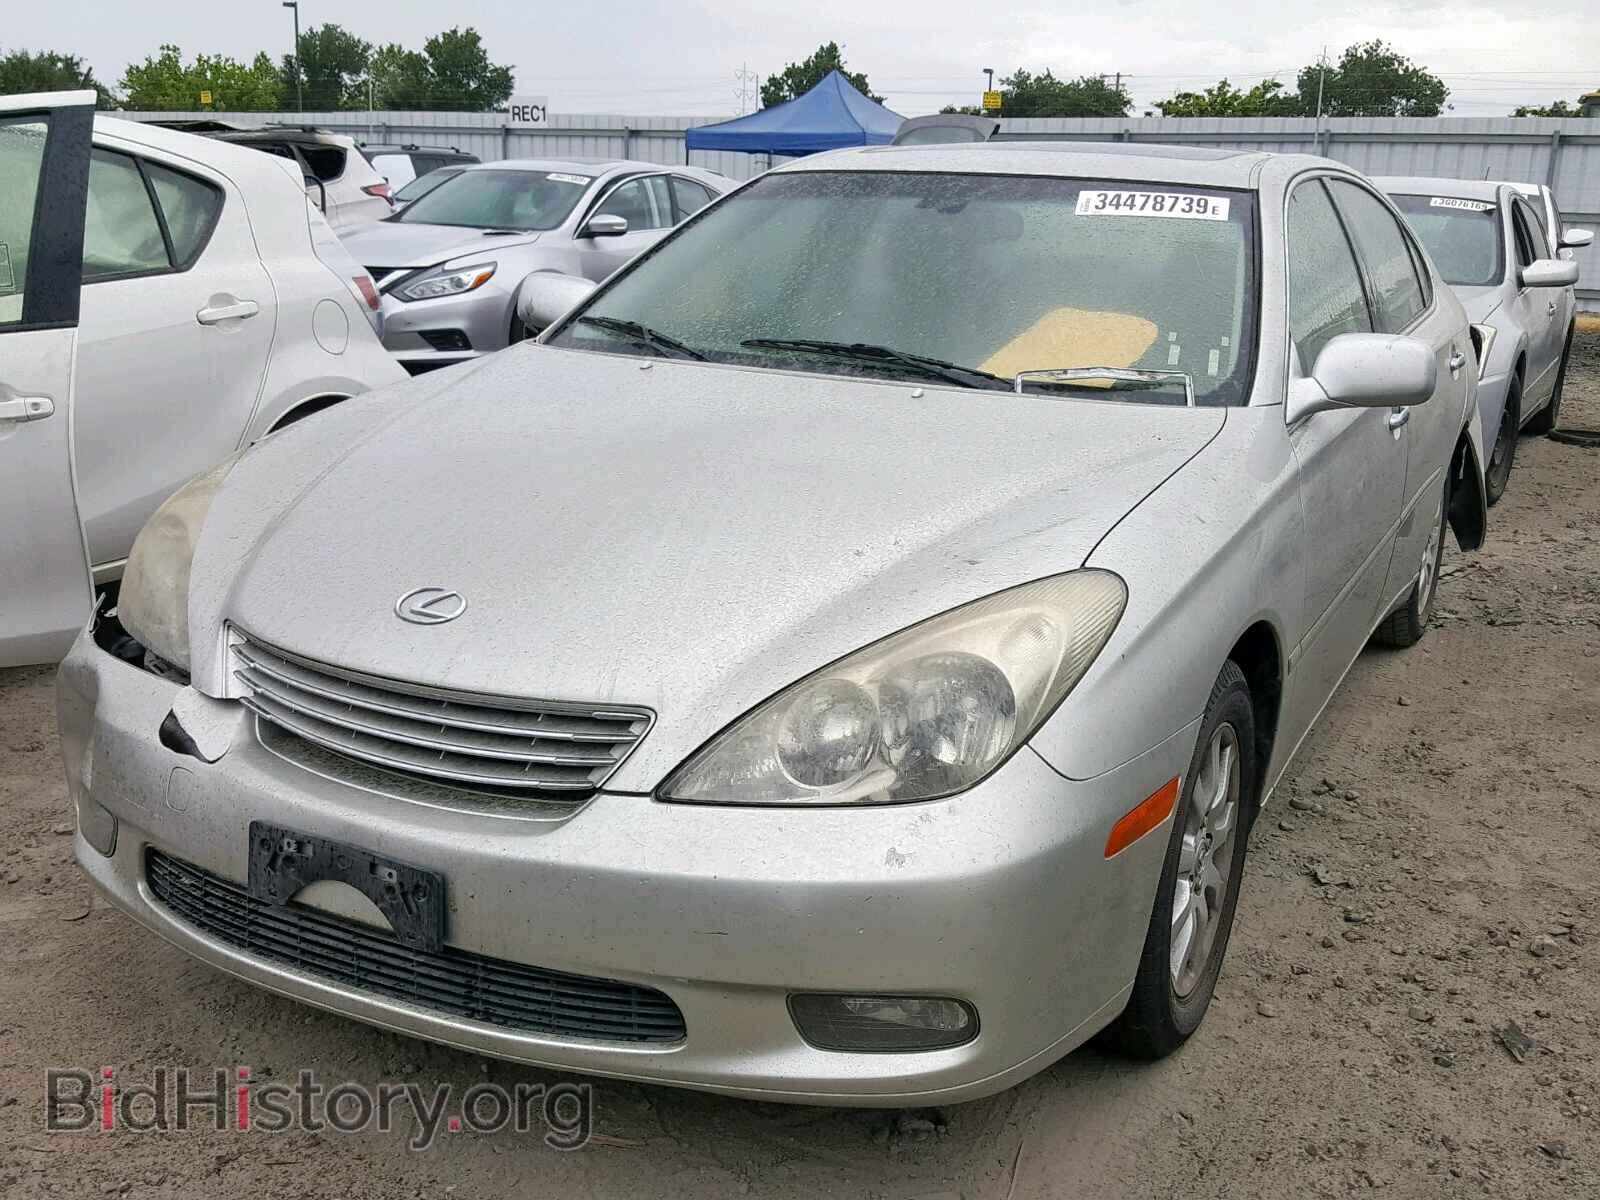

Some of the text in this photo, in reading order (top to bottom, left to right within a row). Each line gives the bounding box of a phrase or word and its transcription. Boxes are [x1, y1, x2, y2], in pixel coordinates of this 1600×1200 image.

[512, 105, 546, 121] REC1
[1094, 192, 1209, 214] 34478739
[1212, 205, 1220, 215] E
